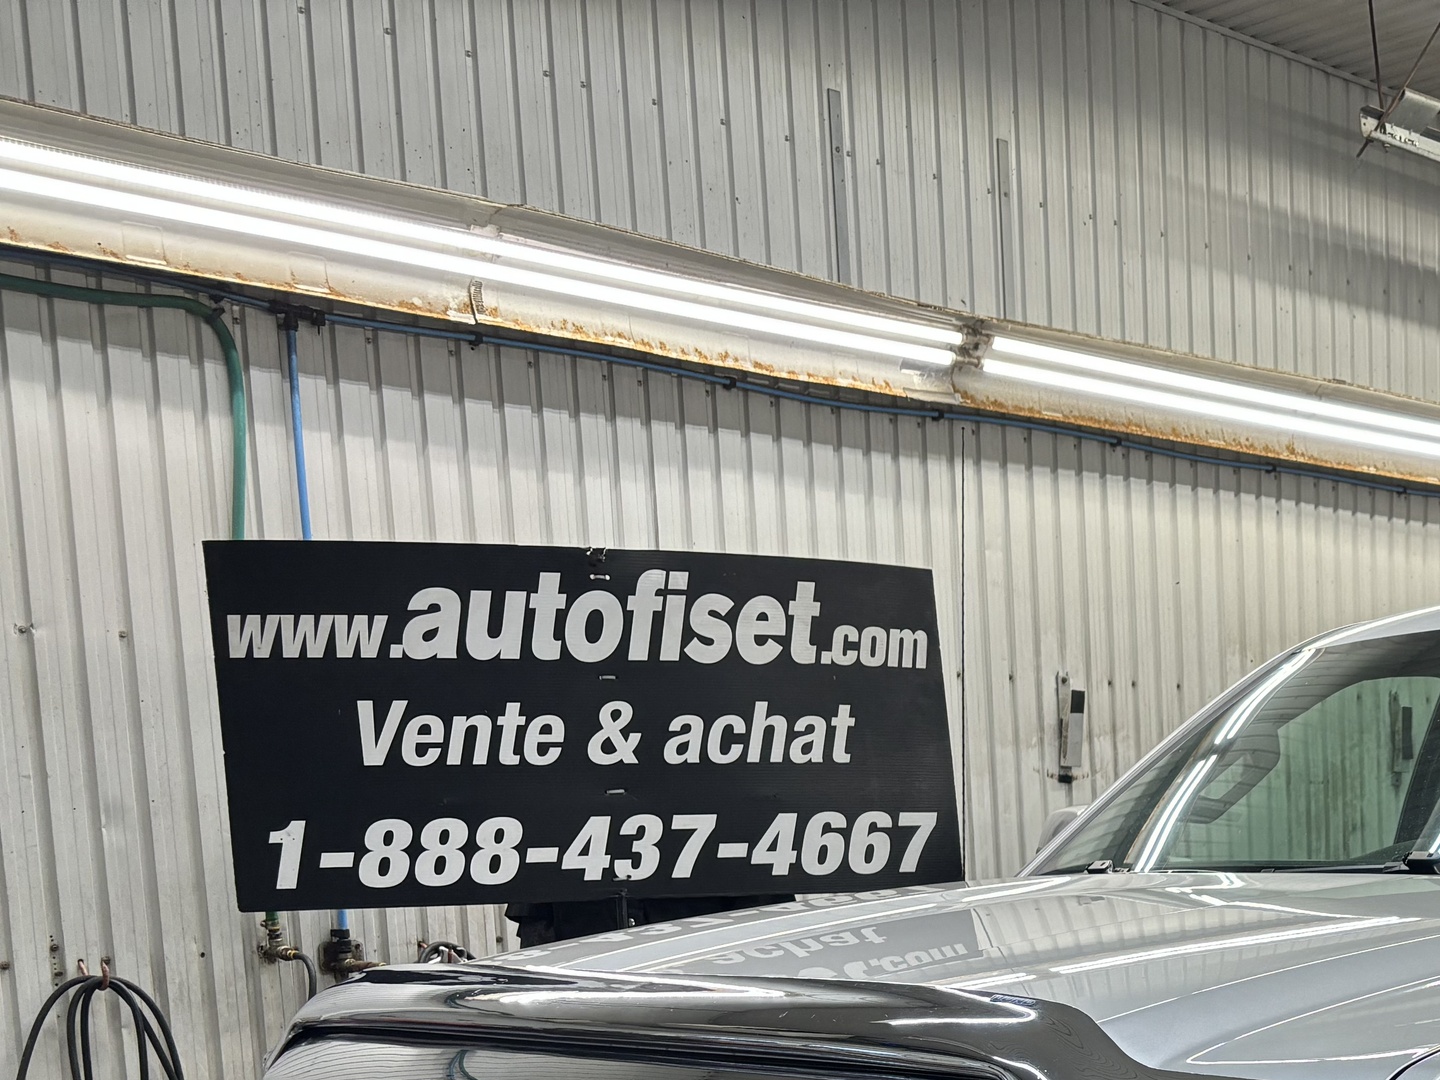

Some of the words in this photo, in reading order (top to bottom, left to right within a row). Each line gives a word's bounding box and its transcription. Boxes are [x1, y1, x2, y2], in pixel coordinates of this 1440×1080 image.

[227, 569, 929, 669] www.autofiset.com
[356, 699, 566, 767] Vente
[587, 700, 641, 765] &
[664, 701, 856, 765] achat
[265, 811, 938, 891] 1-888-437-4667
